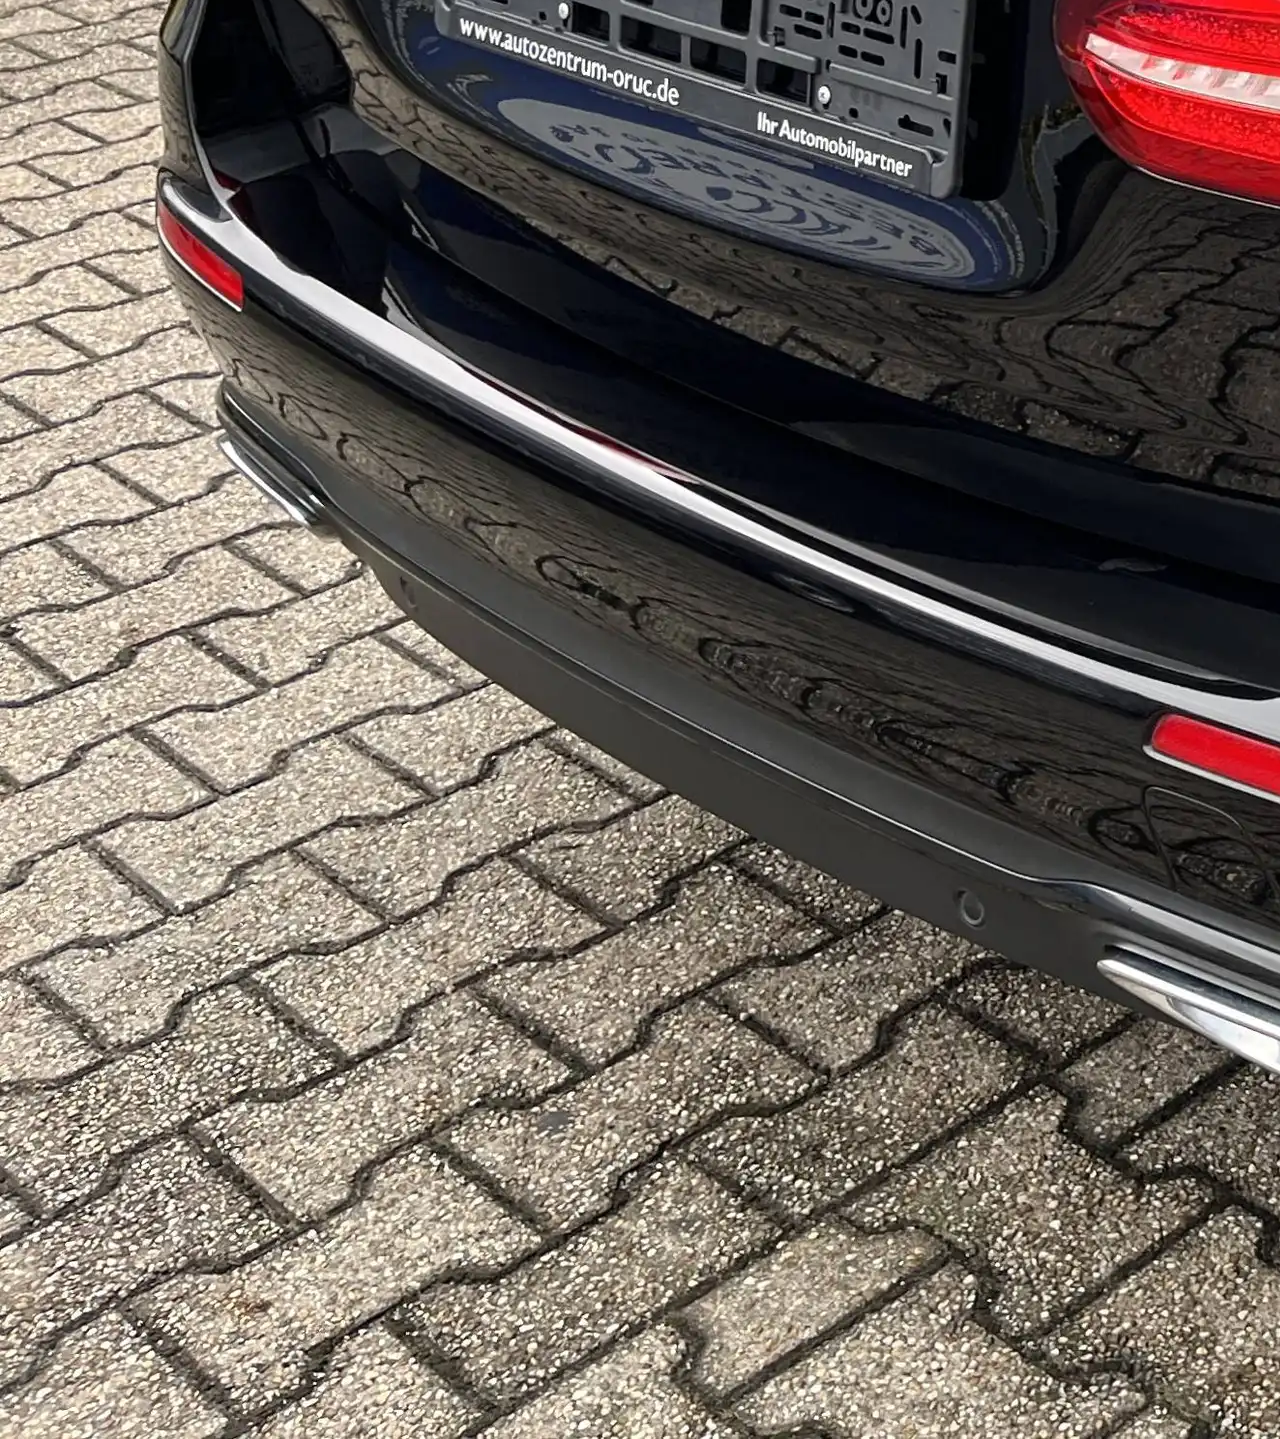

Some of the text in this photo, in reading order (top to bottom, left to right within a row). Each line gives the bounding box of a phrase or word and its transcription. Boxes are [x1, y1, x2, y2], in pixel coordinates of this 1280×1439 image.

[459, 17, 681, 106] www.autozentrum-oruc.de
[757, 111, 913, 178] Ihr Automobilpartner
